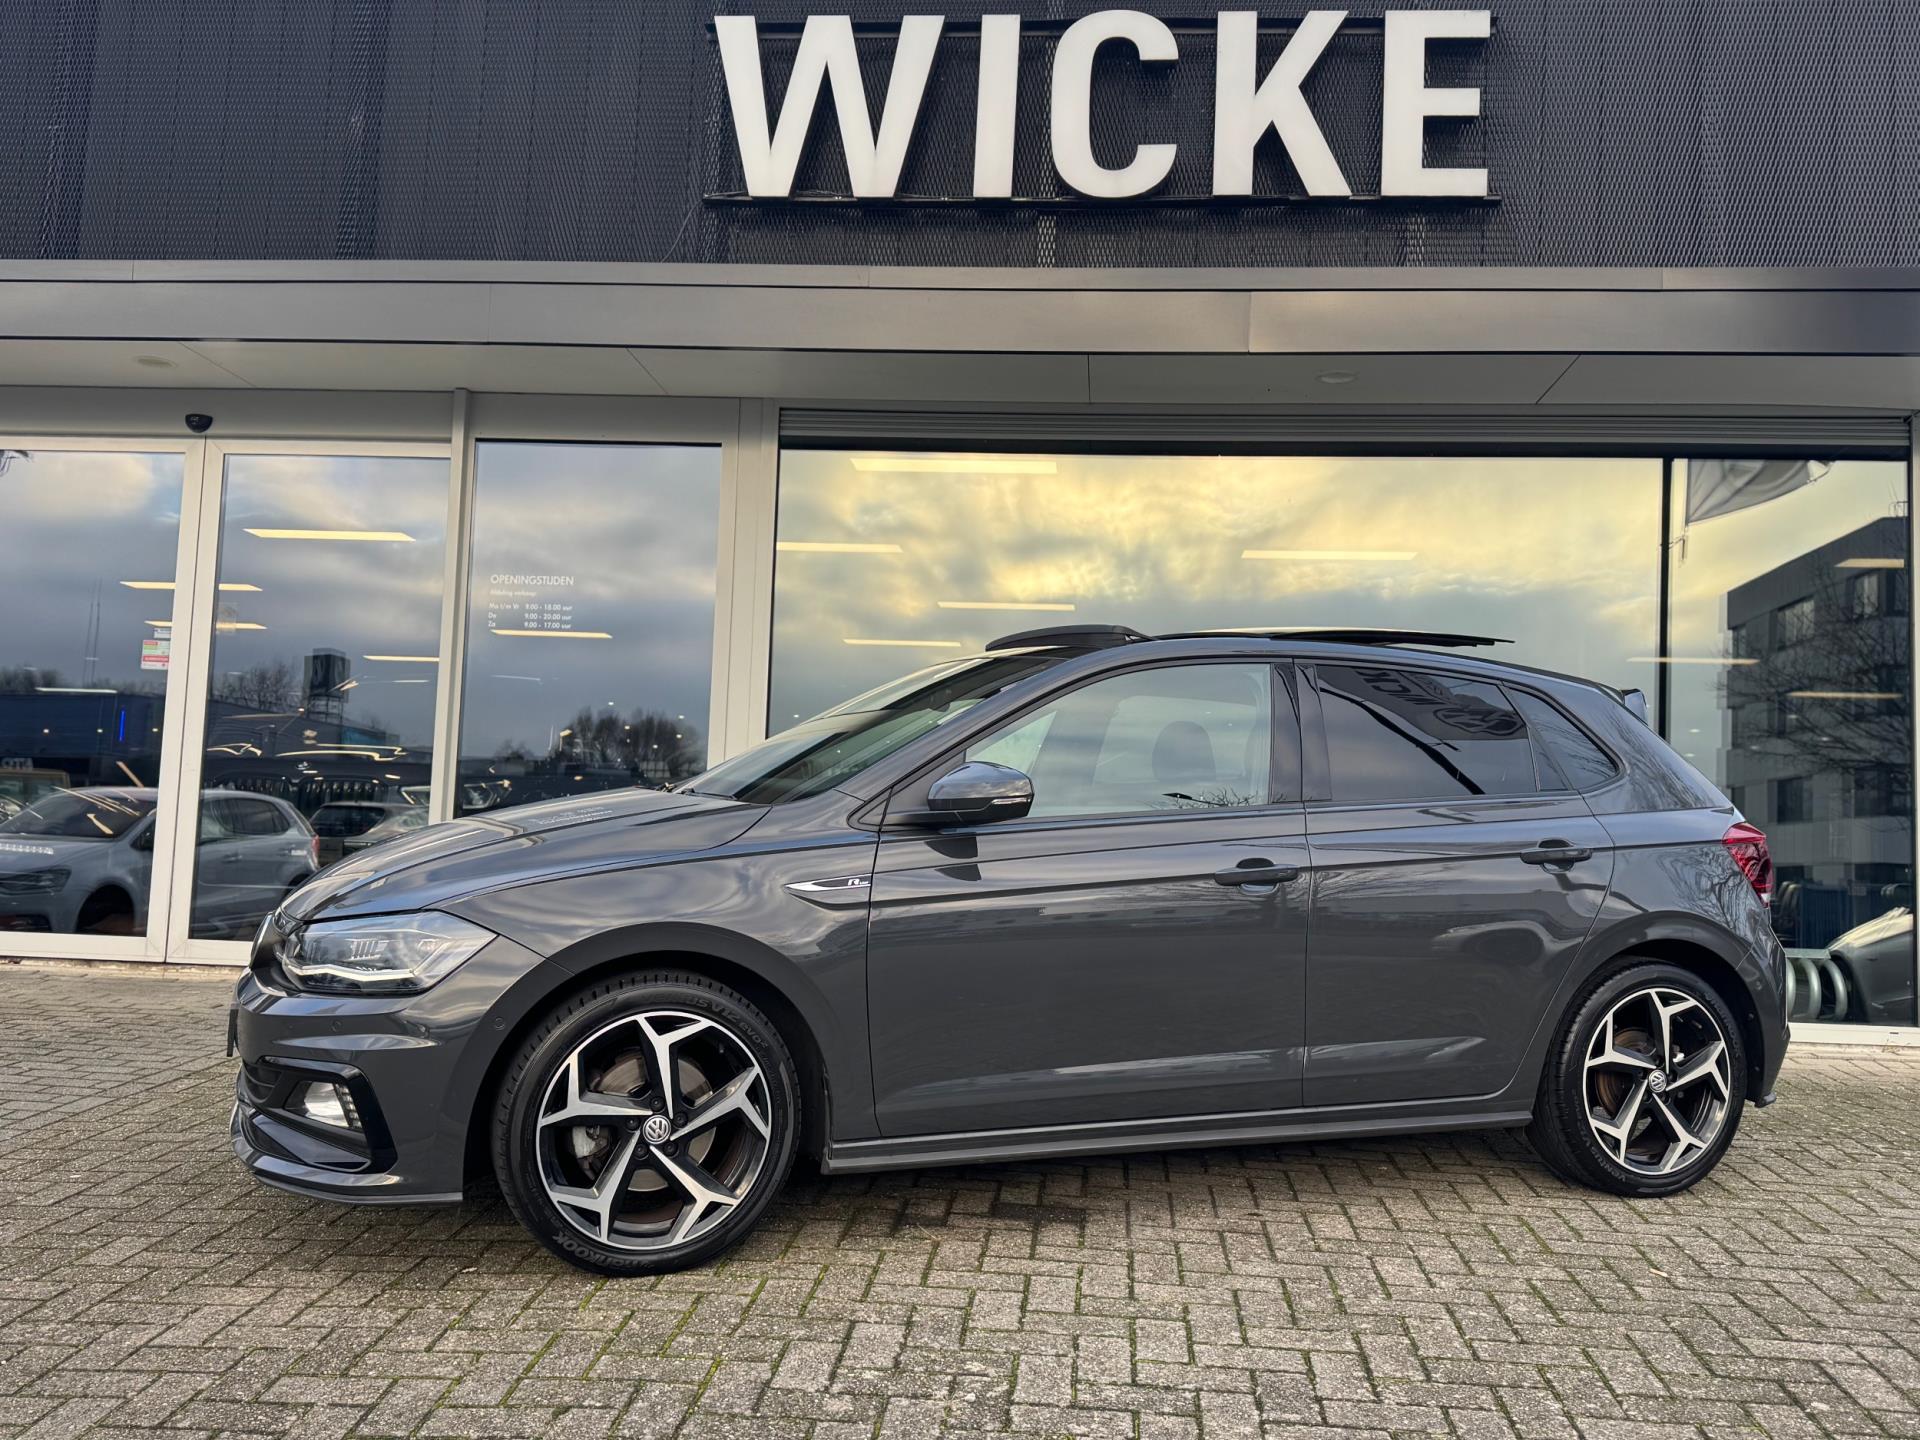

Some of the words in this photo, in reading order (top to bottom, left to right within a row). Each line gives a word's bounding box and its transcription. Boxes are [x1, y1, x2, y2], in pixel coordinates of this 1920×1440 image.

[714, 9, 1491, 198] WICKE
[525, 603, 539, 611] 9.00
[544, 603, 562, 611] 18.00
[524, 621, 538, 629] 9.00
